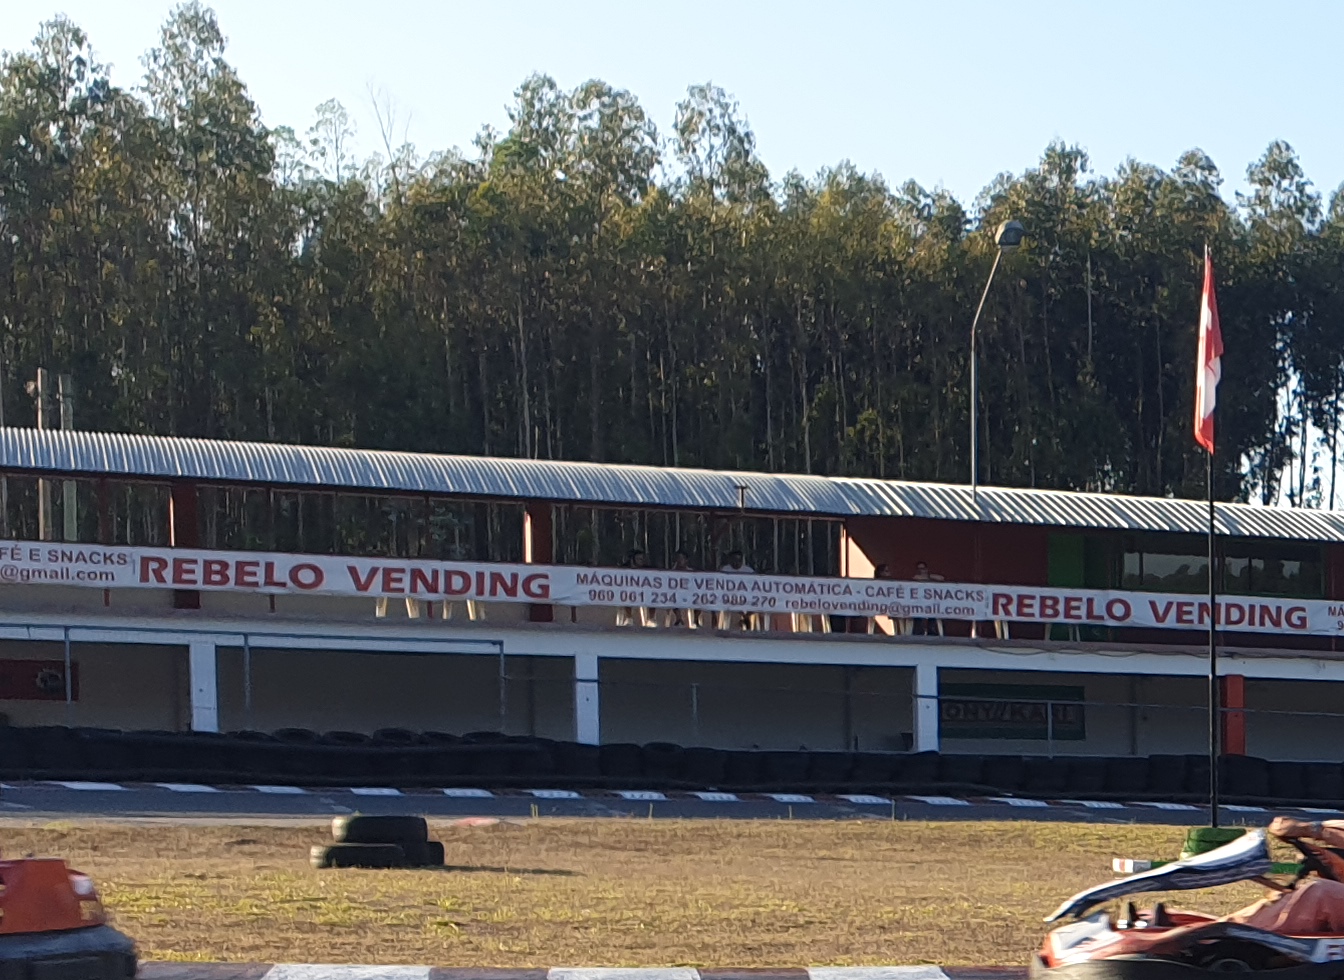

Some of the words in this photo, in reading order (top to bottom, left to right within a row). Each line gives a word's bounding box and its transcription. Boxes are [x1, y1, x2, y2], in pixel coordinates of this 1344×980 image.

[29, 547, 42, 562] E
[47, 549, 129, 566] SNACKS
[0, 564, 115, 583] @gmail.com
[138, 555, 324, 590] REBELO
[346, 565, 551, 599] VENDING
[576, 571, 663, 590] MÁQUINAS
[668, 576, 689, 590] DE
[693, 577, 748, 592] VENDA
[751, 580, 853, 597] AUTOMÁTICA
[865, 584, 905, 599] CAFÉ
[910, 587, 919, 600] E
[923, 588, 985, 602] SNACKS
[651, 592, 677, 605] 234
[750, 595, 777, 608] 270
[991, 592, 1132, 622] REBELO
[1148, 599, 1309, 630] VENDING
